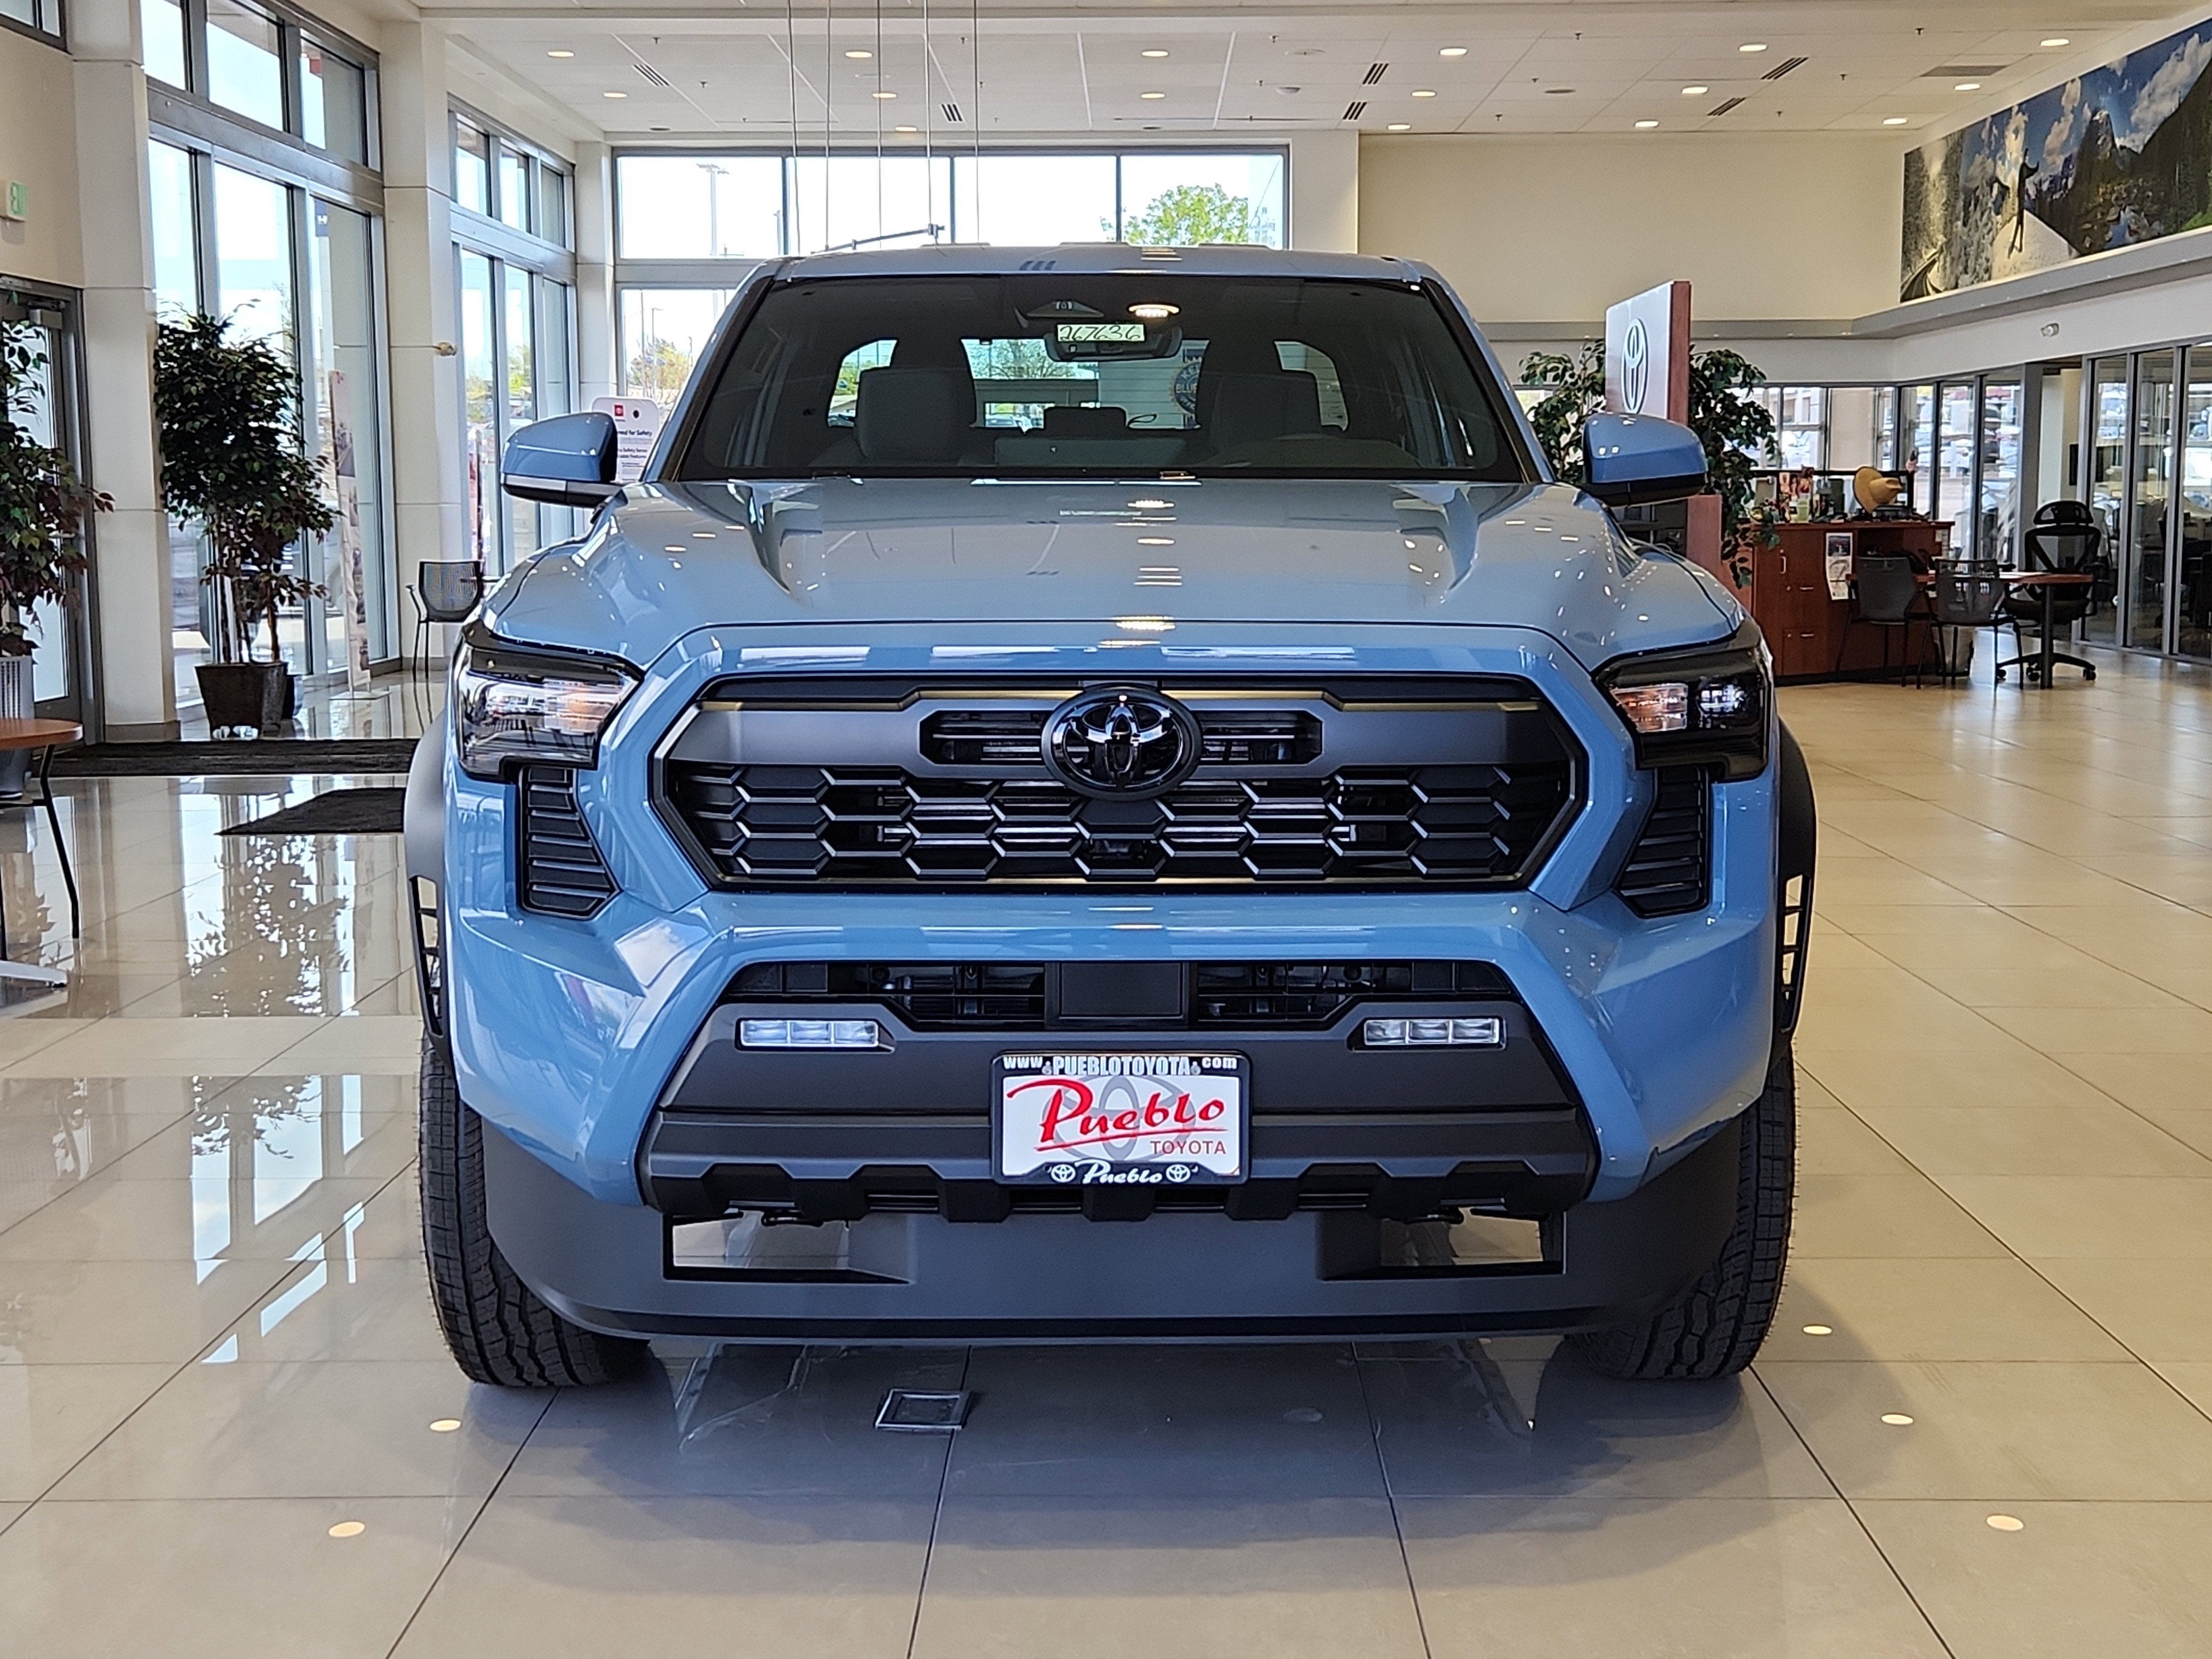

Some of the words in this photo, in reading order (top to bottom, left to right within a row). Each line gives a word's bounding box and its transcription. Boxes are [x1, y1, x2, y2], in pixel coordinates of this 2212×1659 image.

[1059, 325, 1141, 341] 267636
[1006, 1078, 1225, 1143] Pueblo
[1149, 1140, 1226, 1155] TOYOTA
[1074, 1159, 1163, 1184] Pueblo
